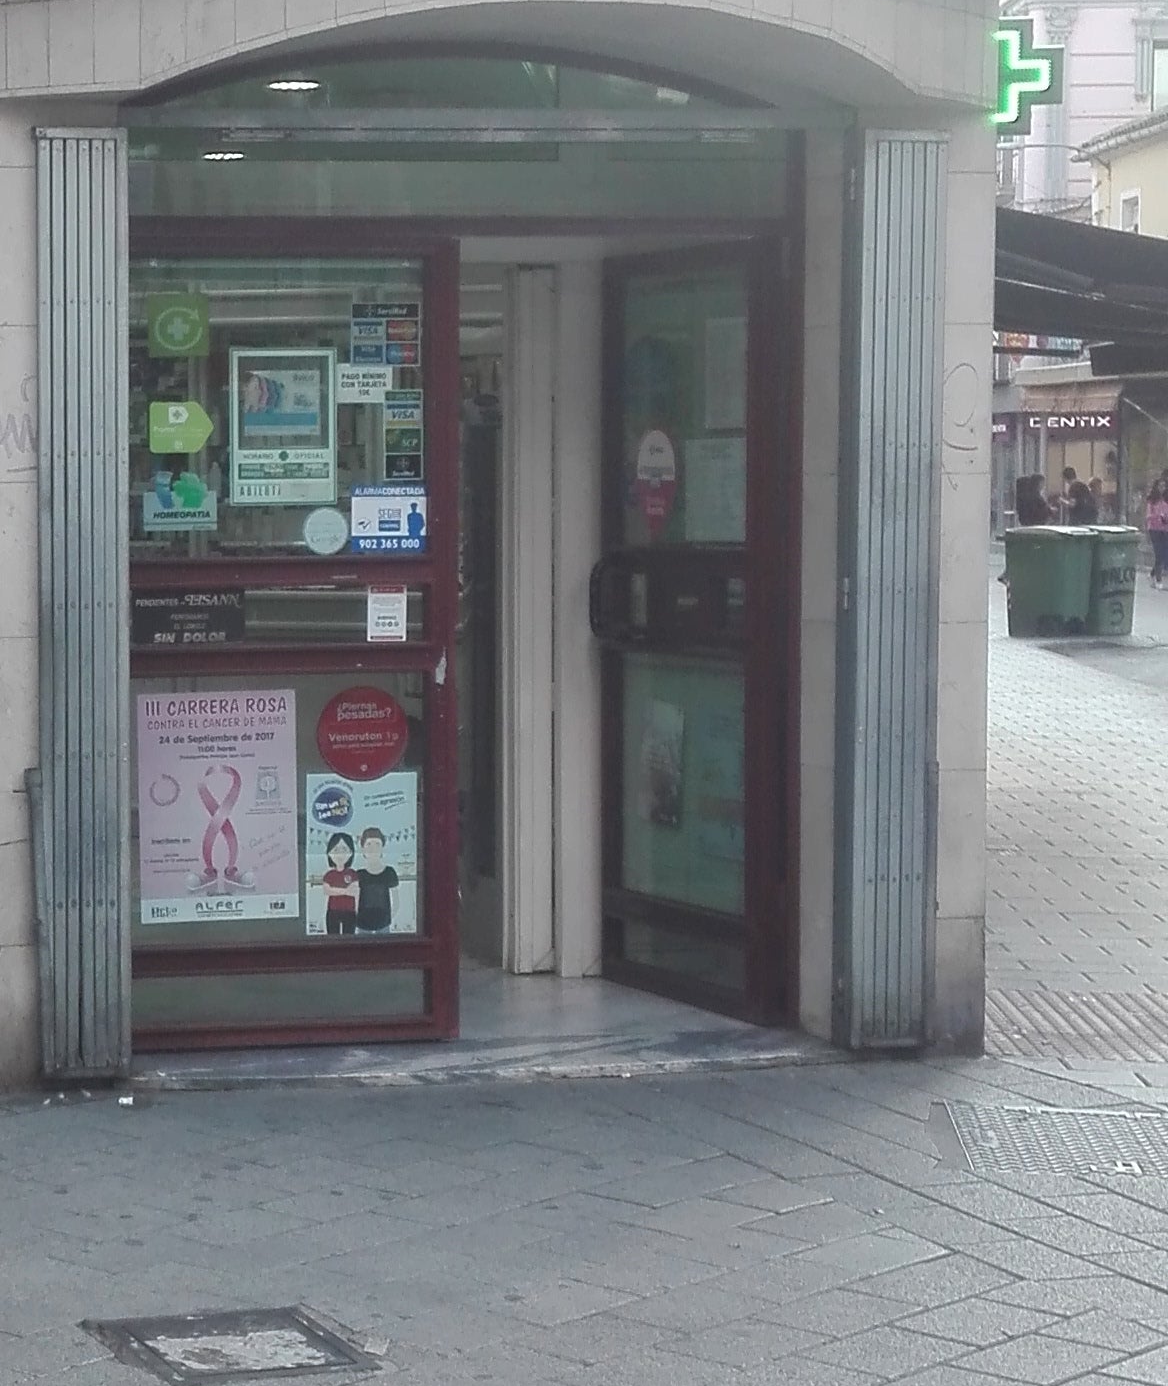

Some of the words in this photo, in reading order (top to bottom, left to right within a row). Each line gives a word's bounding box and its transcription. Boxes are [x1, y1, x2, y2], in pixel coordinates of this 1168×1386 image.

[392, 410, 415, 419] VISA
[359, 538, 378, 549] 902
[380, 538, 398, 549] 365
[401, 538, 420, 549] 000
[153, 632, 176, 643] SIN
[183, 631, 226, 643] DOLOR
[145, 700, 160, 716] III
[167, 698, 240, 717] CARRERA
[246, 696, 287, 713] ROSA
[336, 707, 392, 722] pesadas?
[147, 719, 185, 731] CONTRA
[188, 718, 199, 729] EL
[243, 715, 255, 727] DE
[258, 715, 288, 726] MAMA
[158, 735, 170, 745] 24
[173, 734, 185, 744] de
[187, 733, 238, 745] Septiembre
[241, 732, 252, 742] de
[255, 732, 275, 741] 2017
[328, 732, 383, 742] Venoruton
